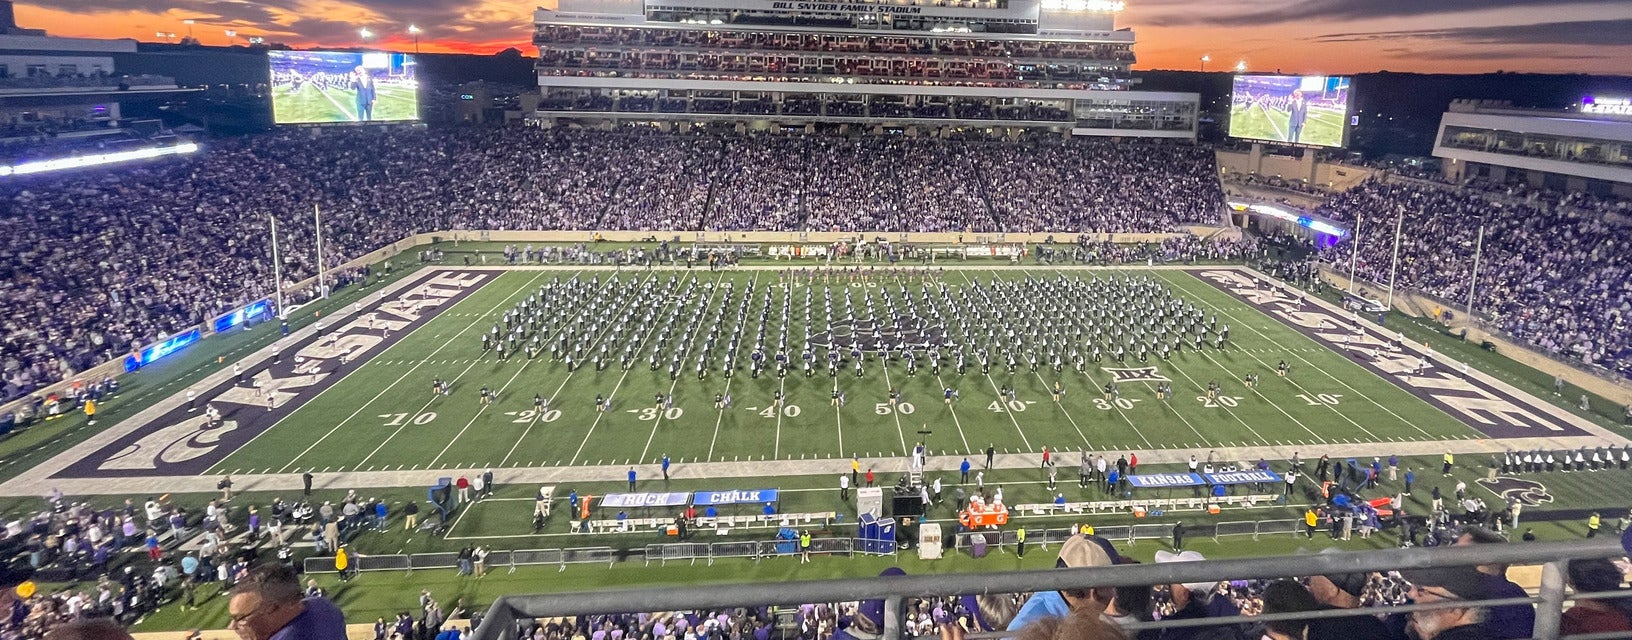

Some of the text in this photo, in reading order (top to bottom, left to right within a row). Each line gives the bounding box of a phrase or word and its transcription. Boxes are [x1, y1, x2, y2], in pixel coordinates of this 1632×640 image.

[797, 3, 838, 11] SNYDER
[840, 4, 875, 12] FAMILY
[878, 5, 922, 14] STADIUM
[1092, 398, 1134, 410] 30
[1196, 395, 1238, 408] 20
[1296, 393, 1340, 406] 10
[759, 404, 801, 418] 40
[875, 402, 915, 415] 50
[987, 400, 1026, 413] 40
[383, 411, 437, 426] 10
[512, 409, 562, 424] 20
[638, 407, 683, 421] 30
[1136, 471, 1275, 486] KANSAS FOOTBALL
[623, 490, 760, 505] ROCK CHALK
